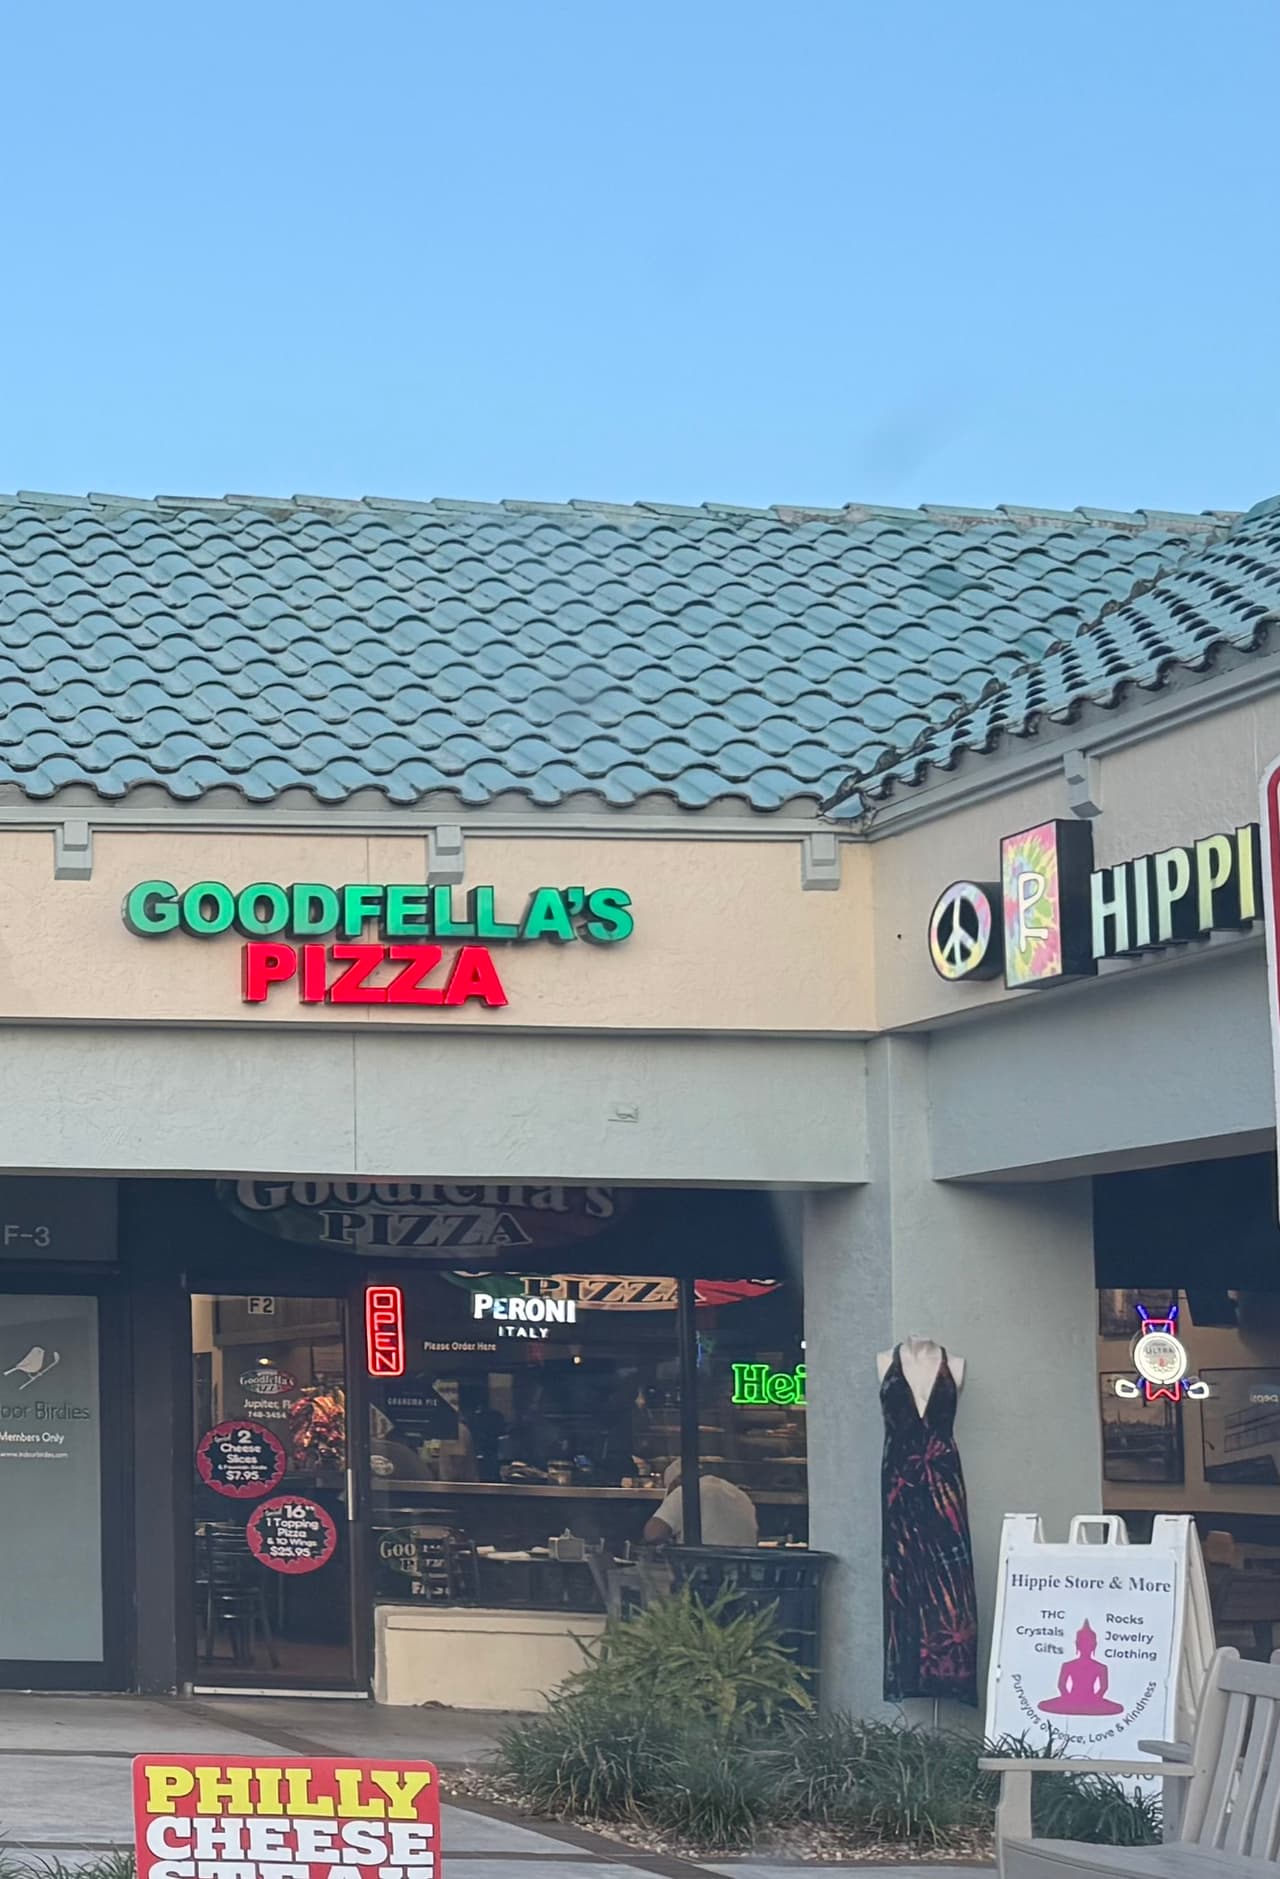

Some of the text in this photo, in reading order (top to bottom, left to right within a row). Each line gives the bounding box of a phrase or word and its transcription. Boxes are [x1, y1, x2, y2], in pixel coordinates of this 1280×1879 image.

[1090, 822, 1261, 961] HIPPI
[121, 879, 635, 945] GOODFELLA'S
[241, 941, 509, 1008] PIZZA
[236, 1180, 614, 1218] Goodeas
[318, 1209, 534, 1247] PIZZA
[3, 1224, 51, 1248] F-3
[519, 1276, 679, 1304] PIZZ
[473, 1292, 577, 1324] PERONI
[372, 1292, 398, 1371] OPEN
[497, 1325, 549, 1339] ITALY
[423, 1341, 497, 1351] Please Order Here
[731, 1363, 808, 1405] Hei
[34, 1401, 91, 1421] Birdies
[41, 1432, 65, 1444] Only
[237, 1429, 252, 1444] 2
[220, 1443, 262, 1453] Cheese
[226, 1453, 258, 1464] Slices
[226, 1470, 260, 1481] $7.95
[273, 1517, 320, 1530] Topping
[277, 1527, 308, 1538] Pizza
[270, 1546, 312, 1558] $25.95
[1011, 1573, 1172, 1593] Hippie Store & More
[1040, 1610, 1066, 1620] THC
[1106, 1613, 1144, 1625] Rocks
[1016, 1625, 1065, 1638] Crystals
[1104, 1631, 1154, 1645] Jewelry
[1034, 1642, 1064, 1655] Gifts
[1104, 1648, 1158, 1662] Clothing
[1011, 1673, 1042, 1725] Purveyors
[1089, 1728, 1115, 1743] Love
[1115, 1722, 1125, 1733] &
[1122, 1681, 1158, 1727] Kindness
[144, 1765, 431, 1820] PHILLY
[145, 1815, 435, 1867] CHEESE
